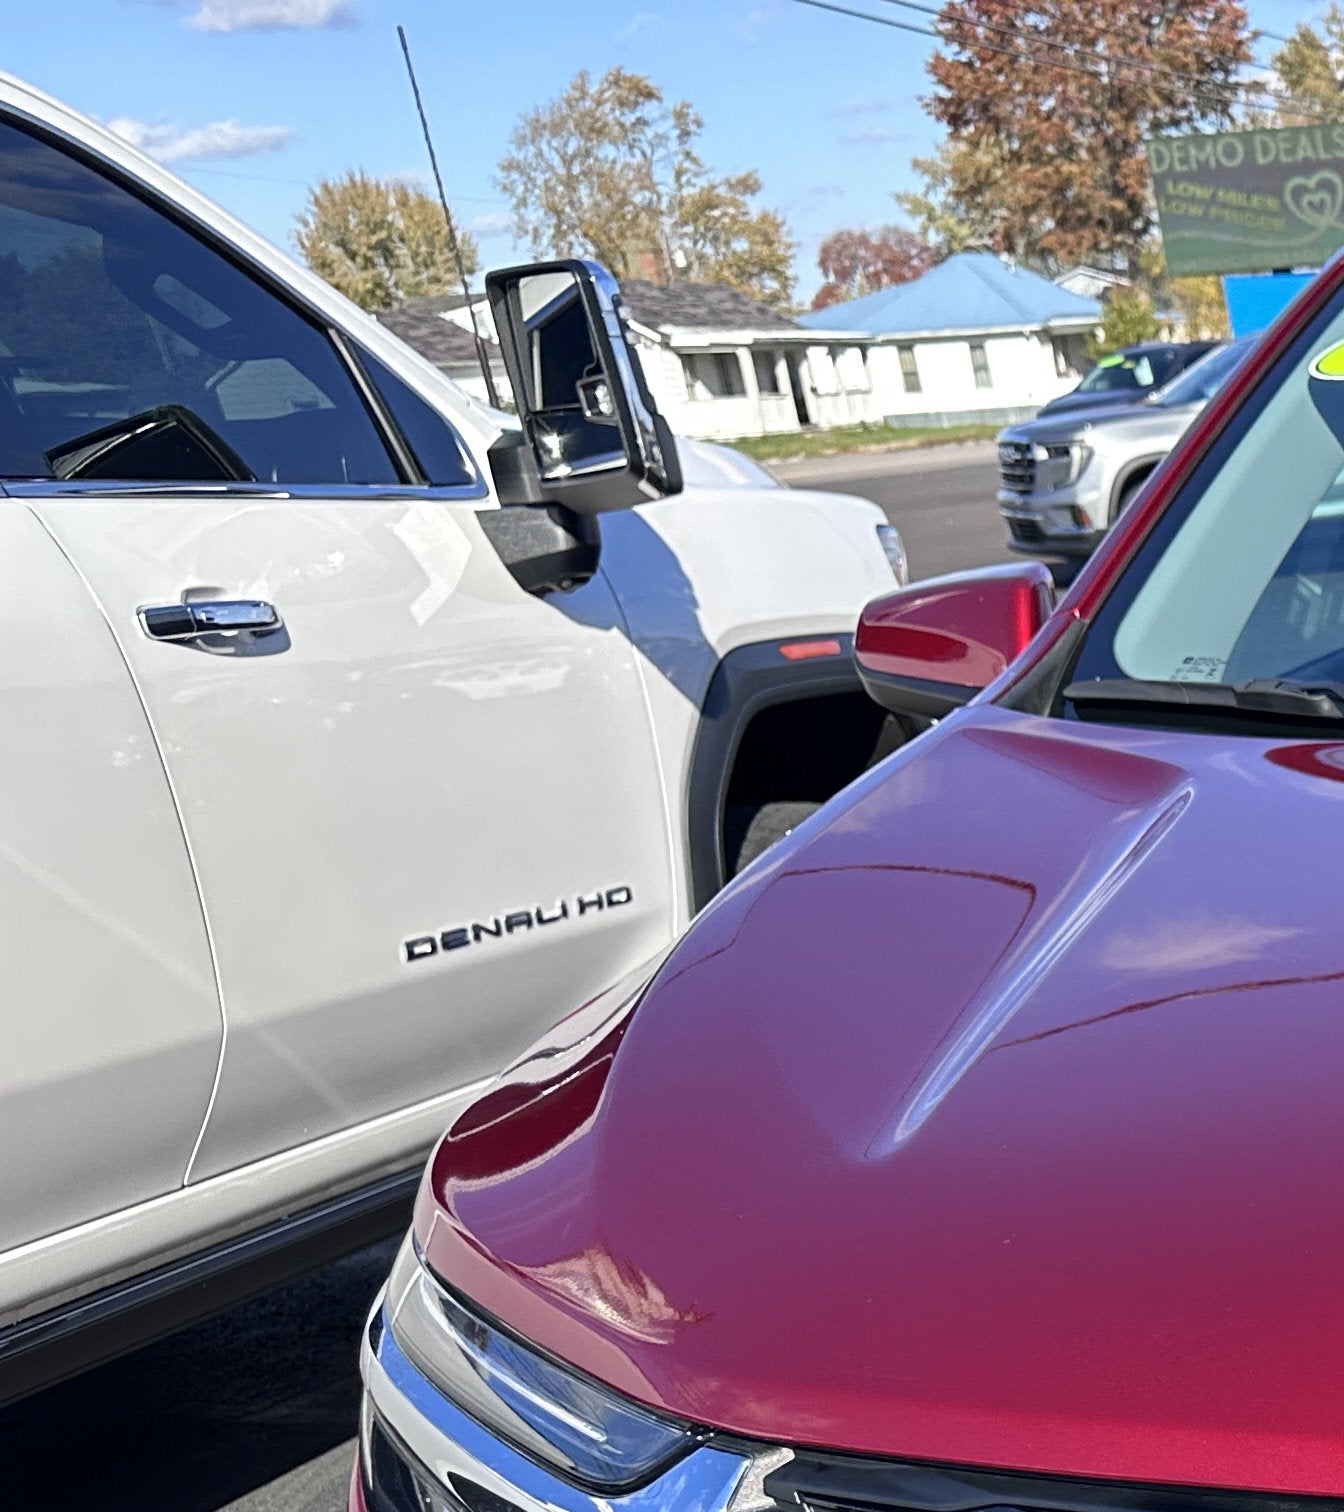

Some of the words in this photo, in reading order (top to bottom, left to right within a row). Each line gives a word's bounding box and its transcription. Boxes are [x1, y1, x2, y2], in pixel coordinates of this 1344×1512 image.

[1151, 136, 1245, 175] DEMO
[404, 899, 569, 962] DENALI
[577, 886, 633, 916] HD
